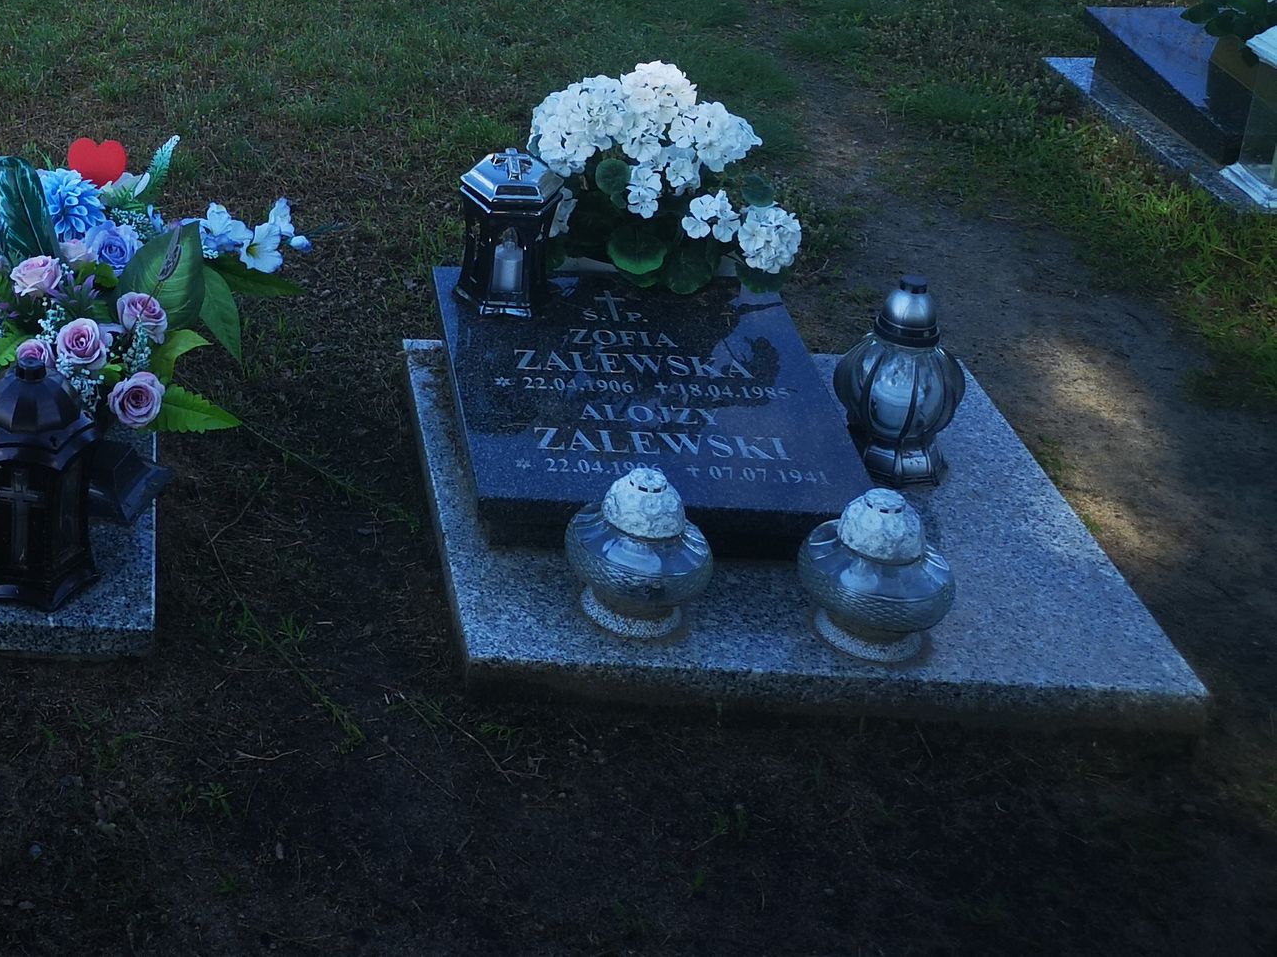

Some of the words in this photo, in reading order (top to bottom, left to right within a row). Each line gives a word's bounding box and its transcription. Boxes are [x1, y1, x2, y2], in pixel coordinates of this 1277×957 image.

[569, 328, 679, 348] ZOFIA
[513, 348, 756, 380] ZALEWSKA
[522, 375, 635, 394] 22.04.1906
[579, 402, 719, 426] ALOJZY
[533, 426, 792, 461] ZALEWSKI
